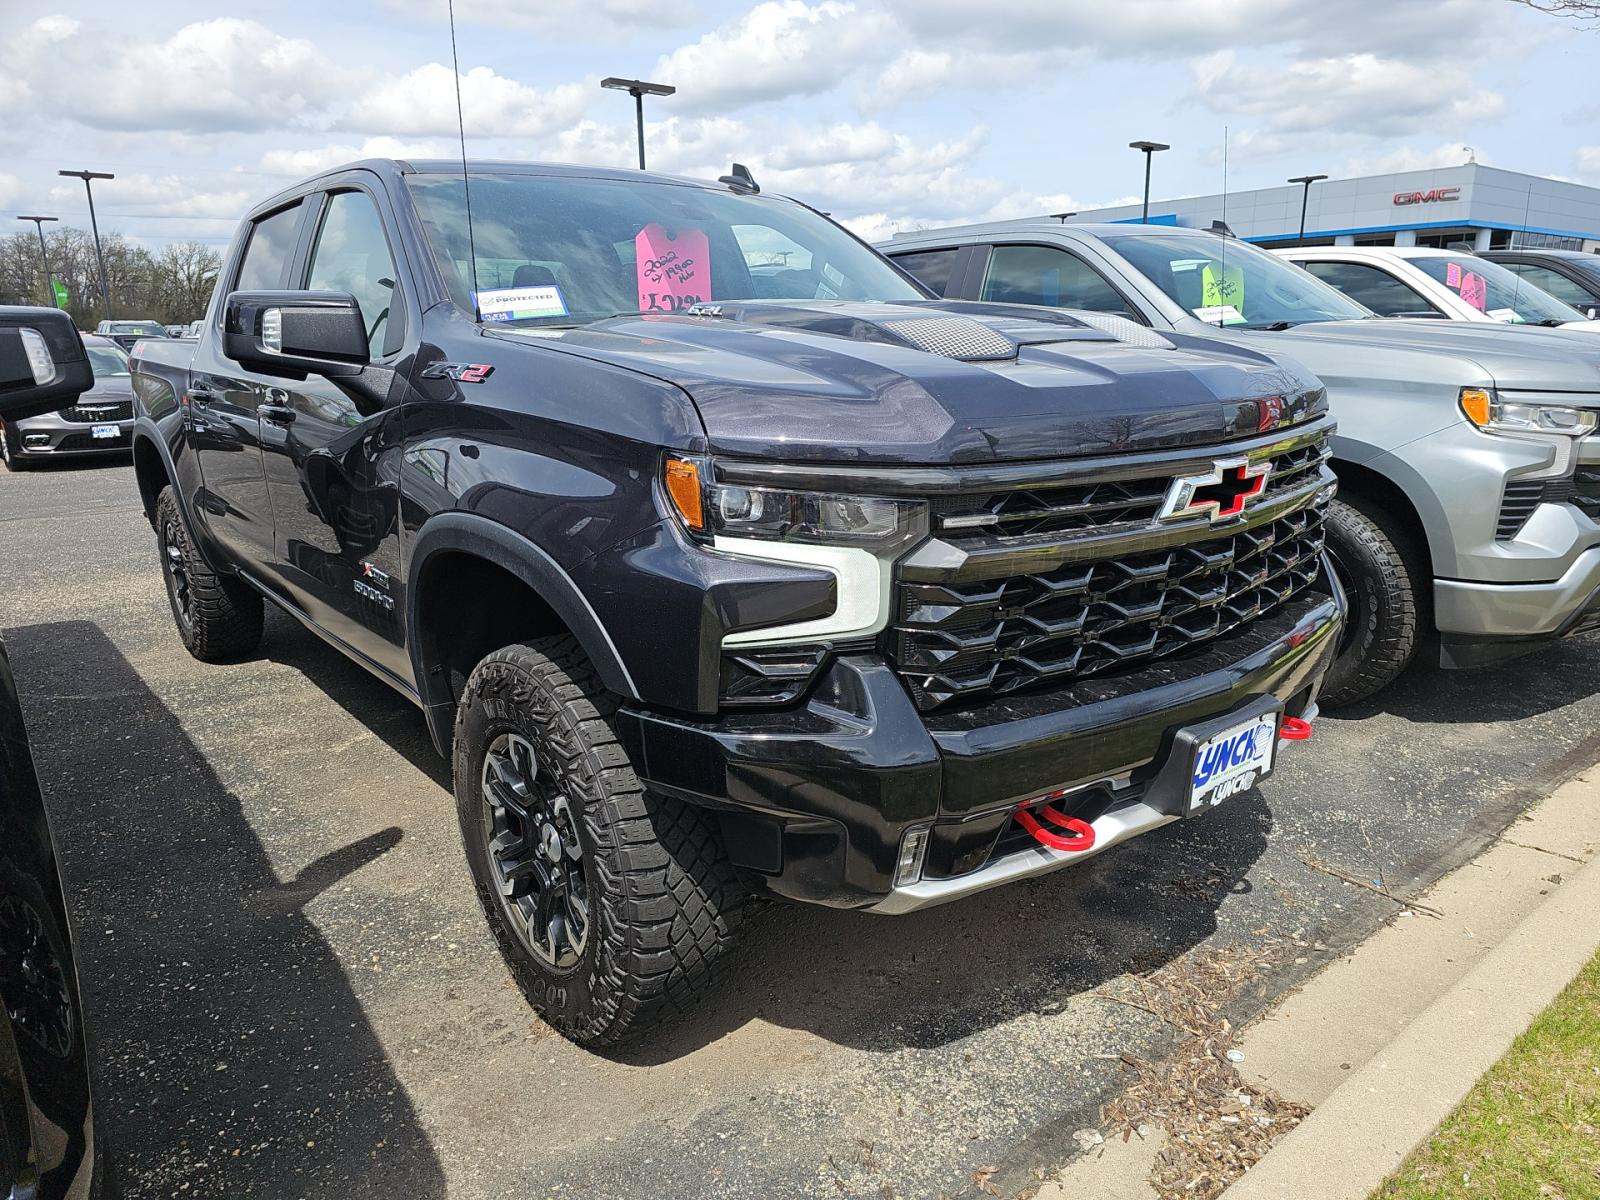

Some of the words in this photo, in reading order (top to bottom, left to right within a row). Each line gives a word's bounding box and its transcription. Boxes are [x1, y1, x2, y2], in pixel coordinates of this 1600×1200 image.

[1393, 187, 1461, 206] GMC
[643, 250, 678, 278] 2022
[495, 293, 554, 303] PROTECTED
[421, 360, 496, 384] ZR2
[1193, 728, 1259, 789] LYNCH
